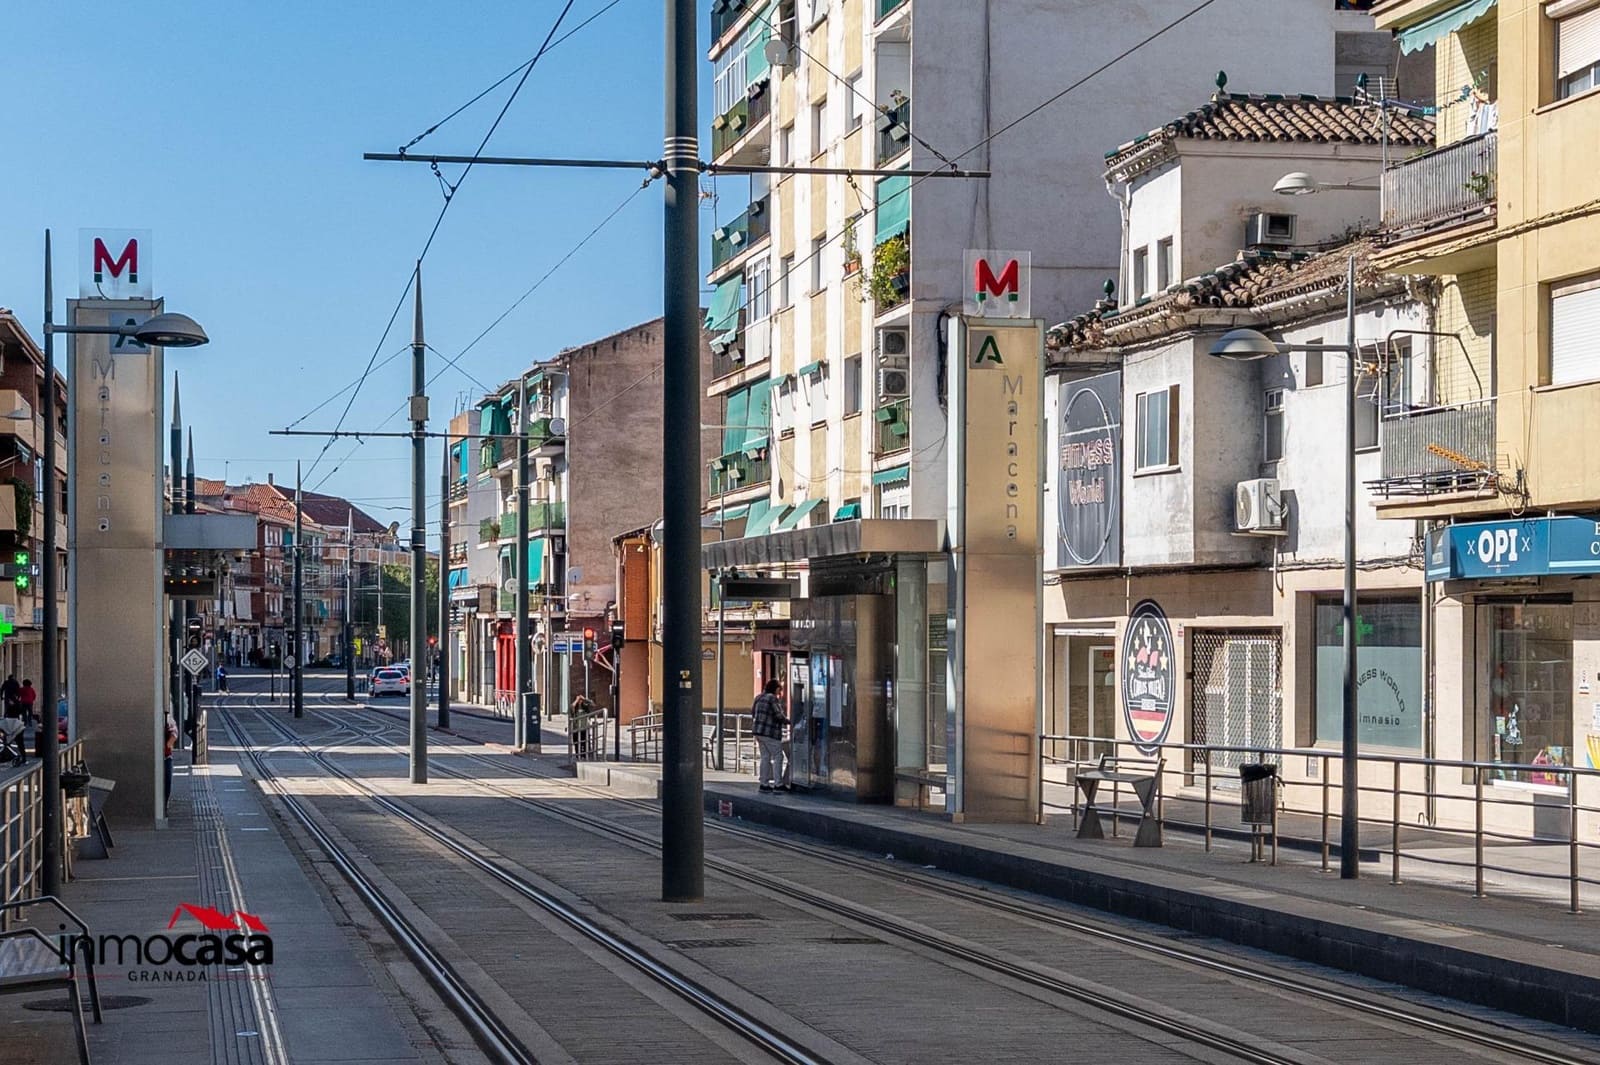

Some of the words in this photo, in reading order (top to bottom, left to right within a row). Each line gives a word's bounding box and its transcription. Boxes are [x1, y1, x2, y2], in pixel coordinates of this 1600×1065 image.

[94, 237, 138, 283] M
[975, 258, 1019, 302] M
[92, 358, 116, 533] Maracena
[1003, 375, 1023, 542] Maracena
[1477, 528, 1518, 564] OPI
[1356, 668, 1377, 690] NESS
[1380, 670, 1405, 712] WORLD
[1359, 712, 1400, 725] imnasio
